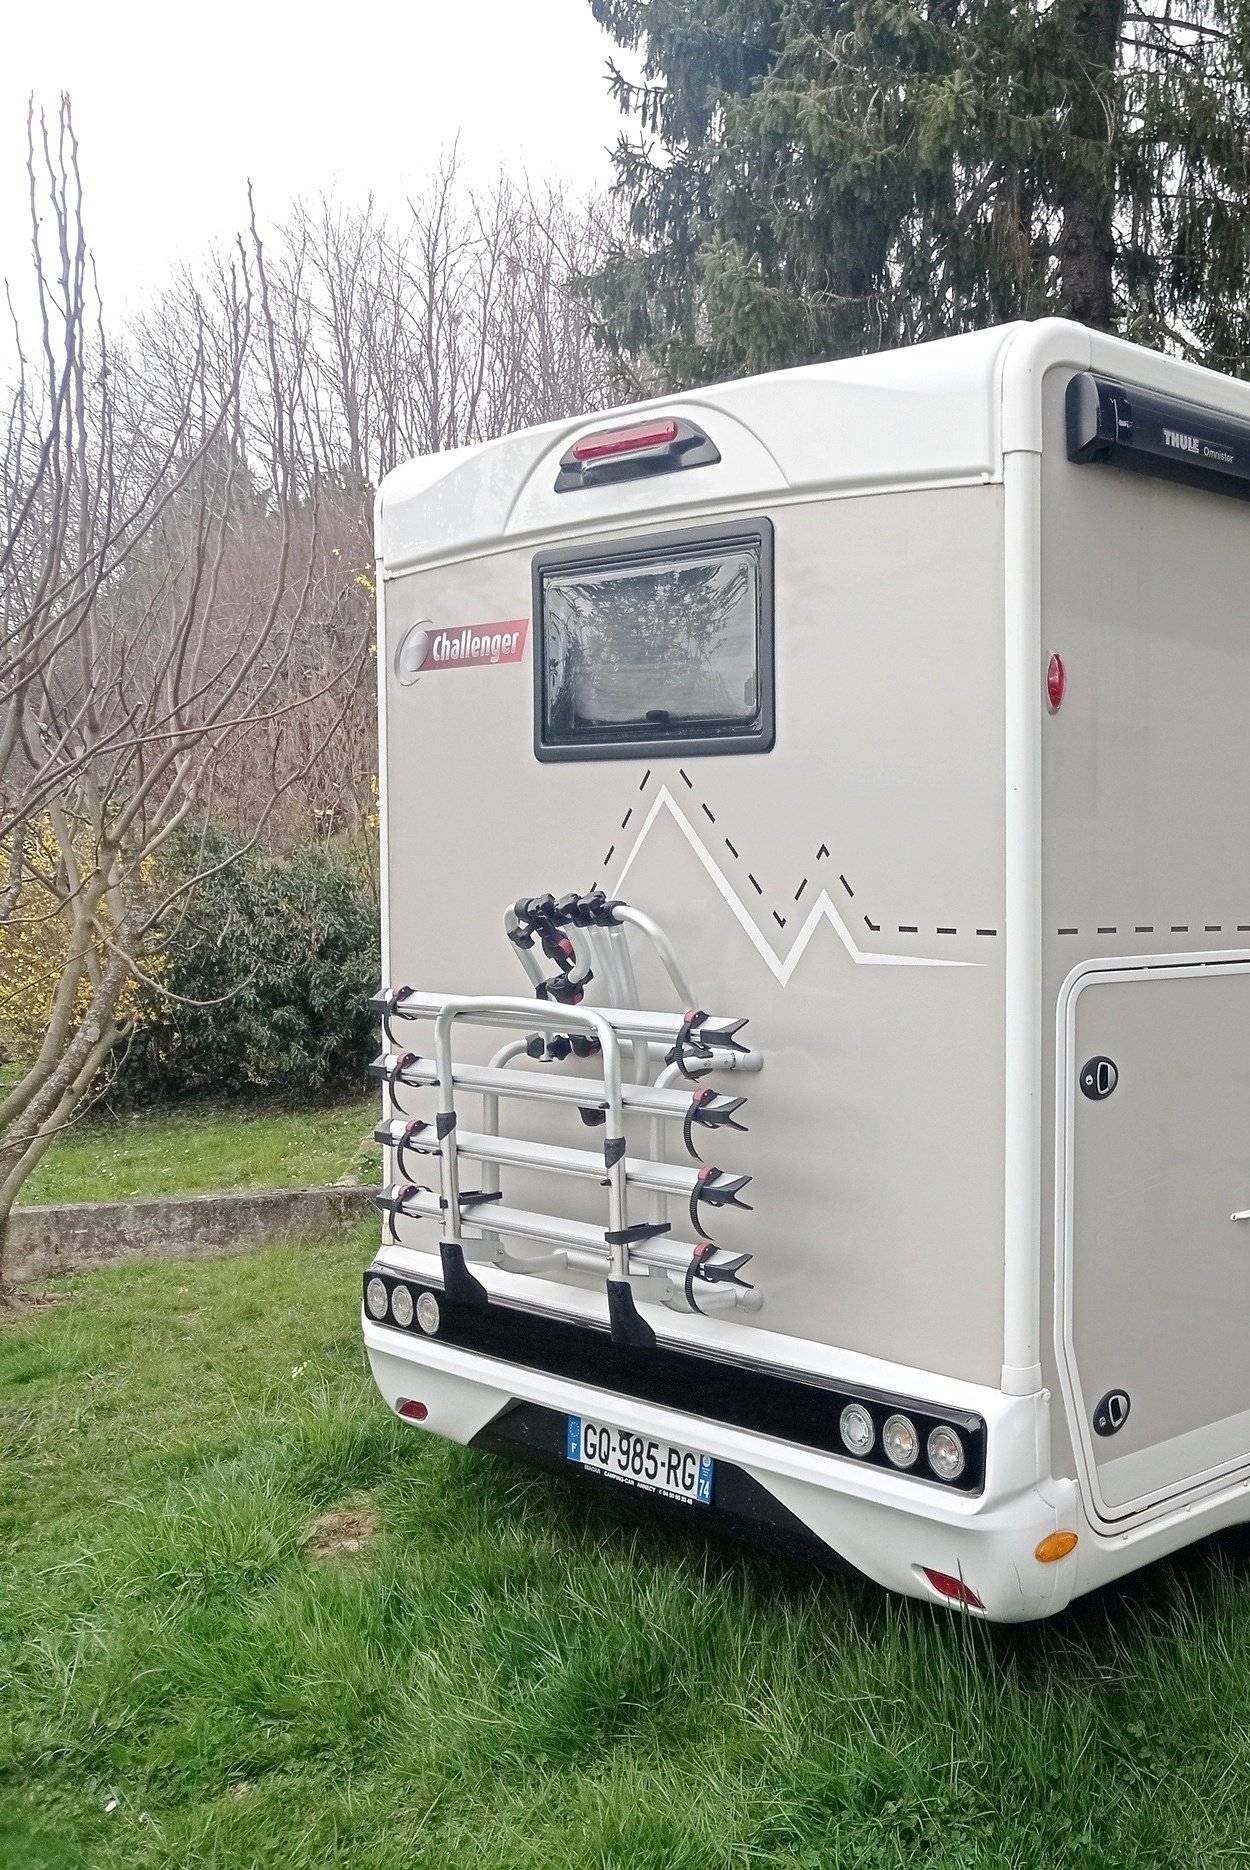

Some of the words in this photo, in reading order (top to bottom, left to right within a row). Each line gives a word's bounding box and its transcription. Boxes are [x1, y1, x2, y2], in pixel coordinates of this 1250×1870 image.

[1162, 427, 1200, 454] THULE
[1203, 446, 1234, 464] Omnistor
[432, 629, 520, 663] Challenger
[583, 1423, 696, 1491] GQ-985-RG
[699, 1479, 710, 1499] 74
